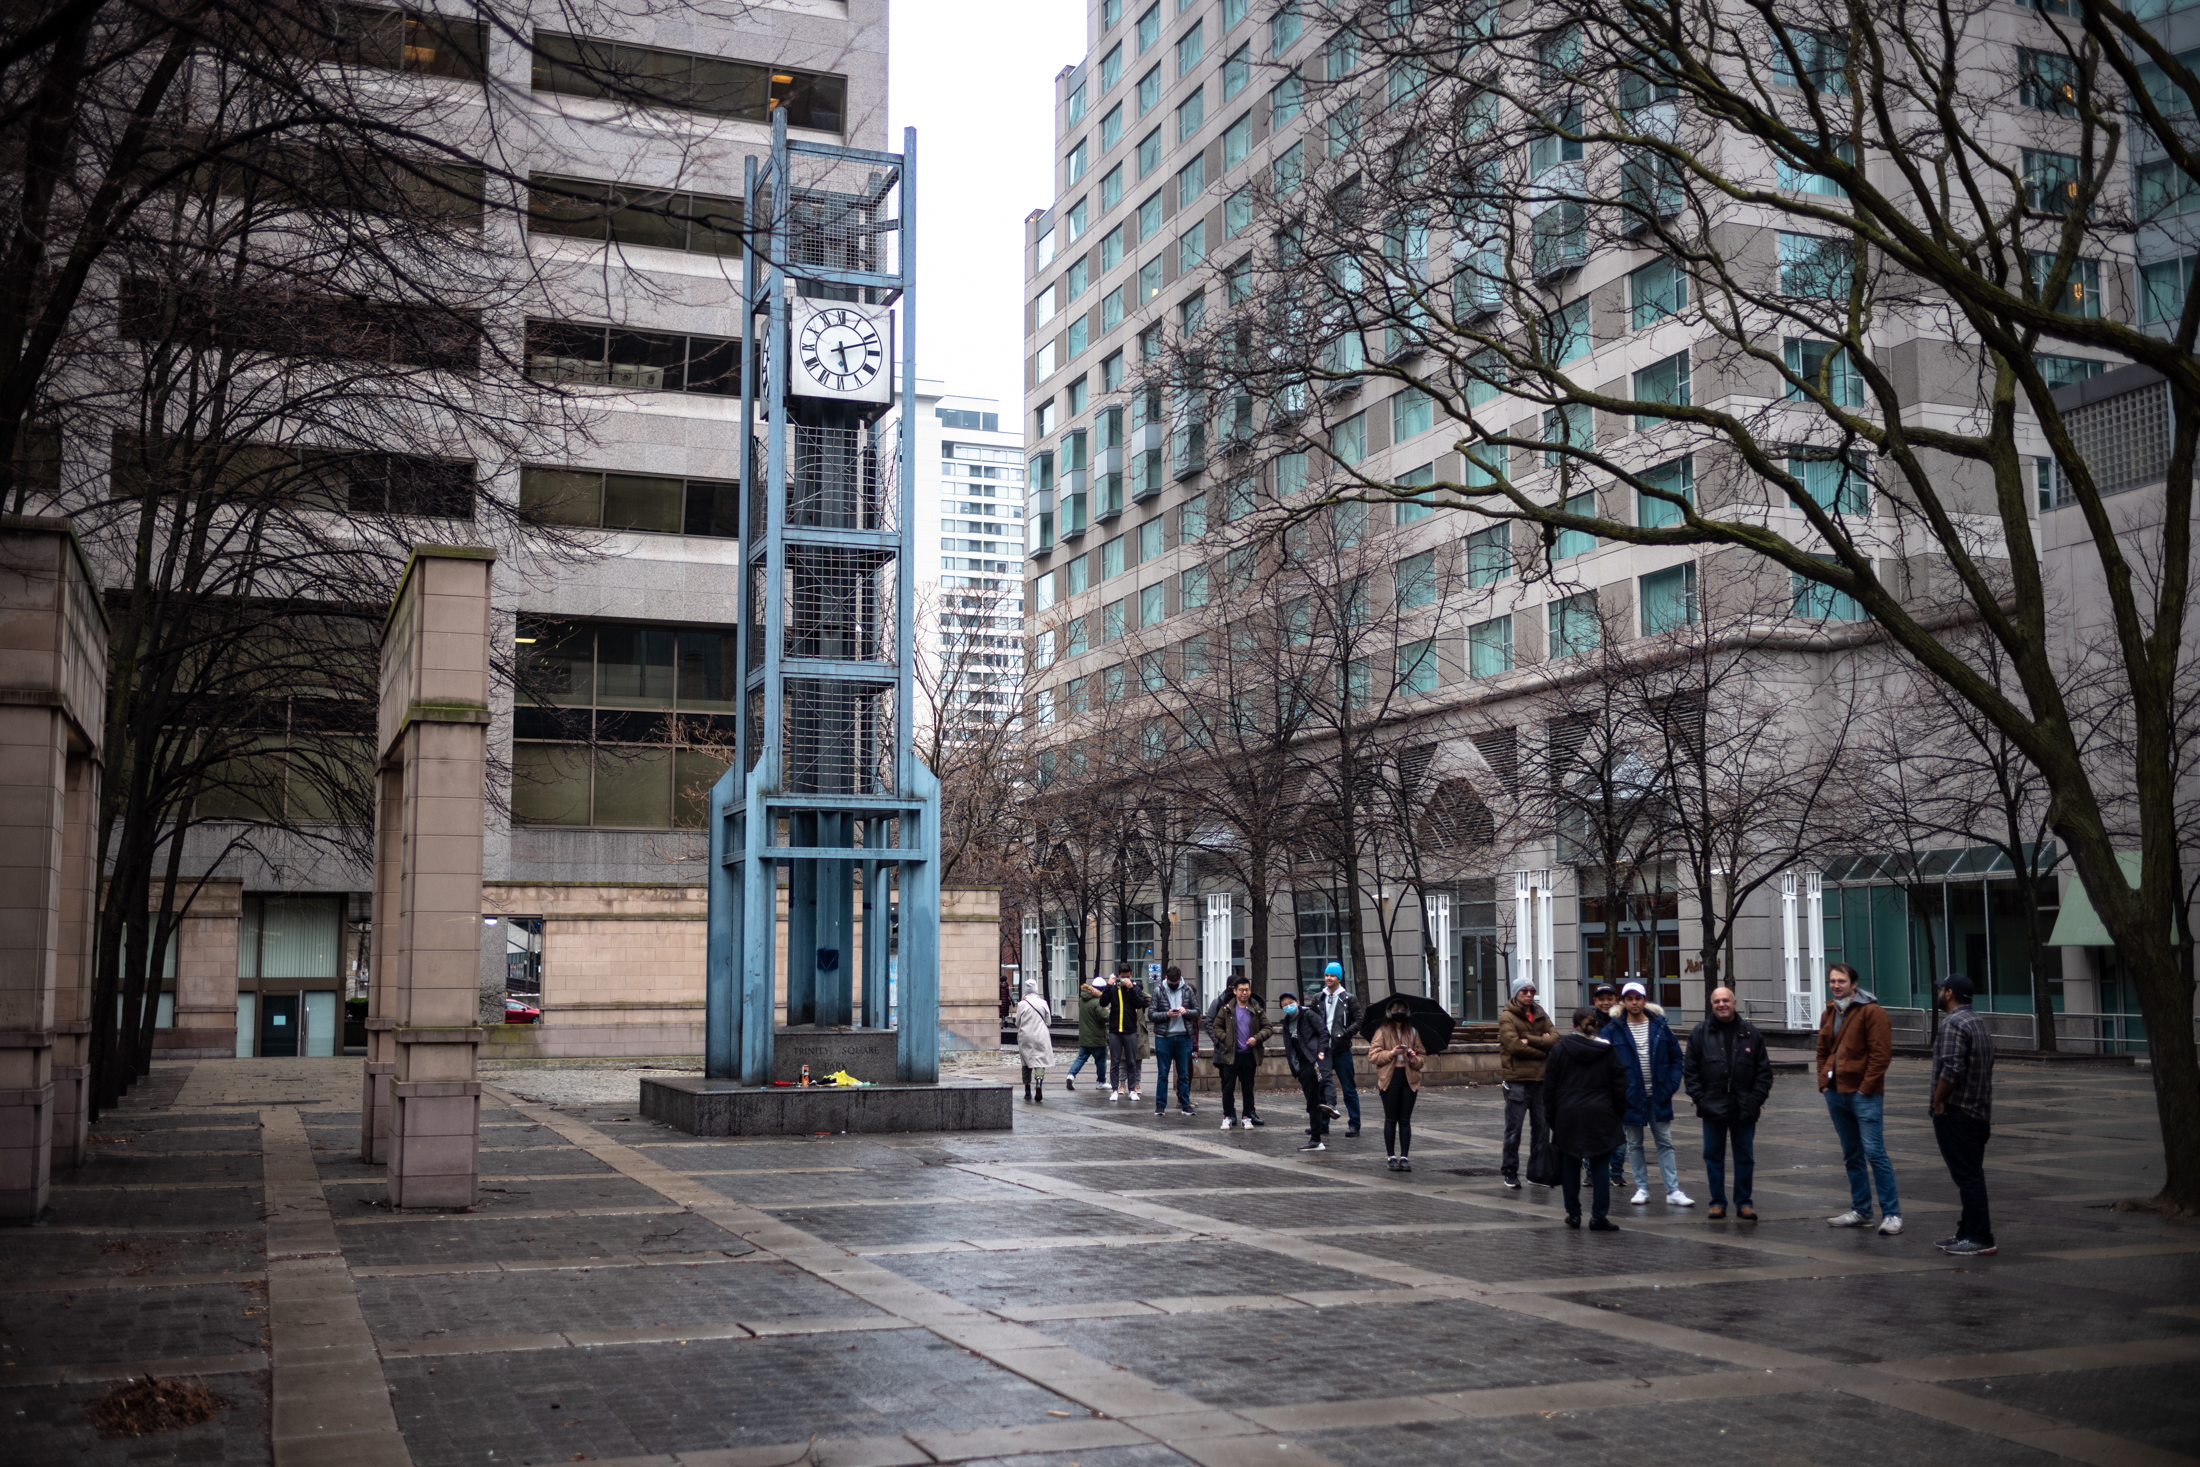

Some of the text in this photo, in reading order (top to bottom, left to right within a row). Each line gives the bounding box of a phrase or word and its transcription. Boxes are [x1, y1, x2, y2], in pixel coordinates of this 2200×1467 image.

[836, 310, 846, 325] XII
[853, 318, 862, 330] I
[802, 343, 815, 351] IX
[818, 370, 830, 384] VII
[837, 376, 845, 390] VI
[853, 374, 863, 387] V
[794, 1046, 880, 1055] TRINITY SQUARE
[824, 1062, 847, 1070] PARK
